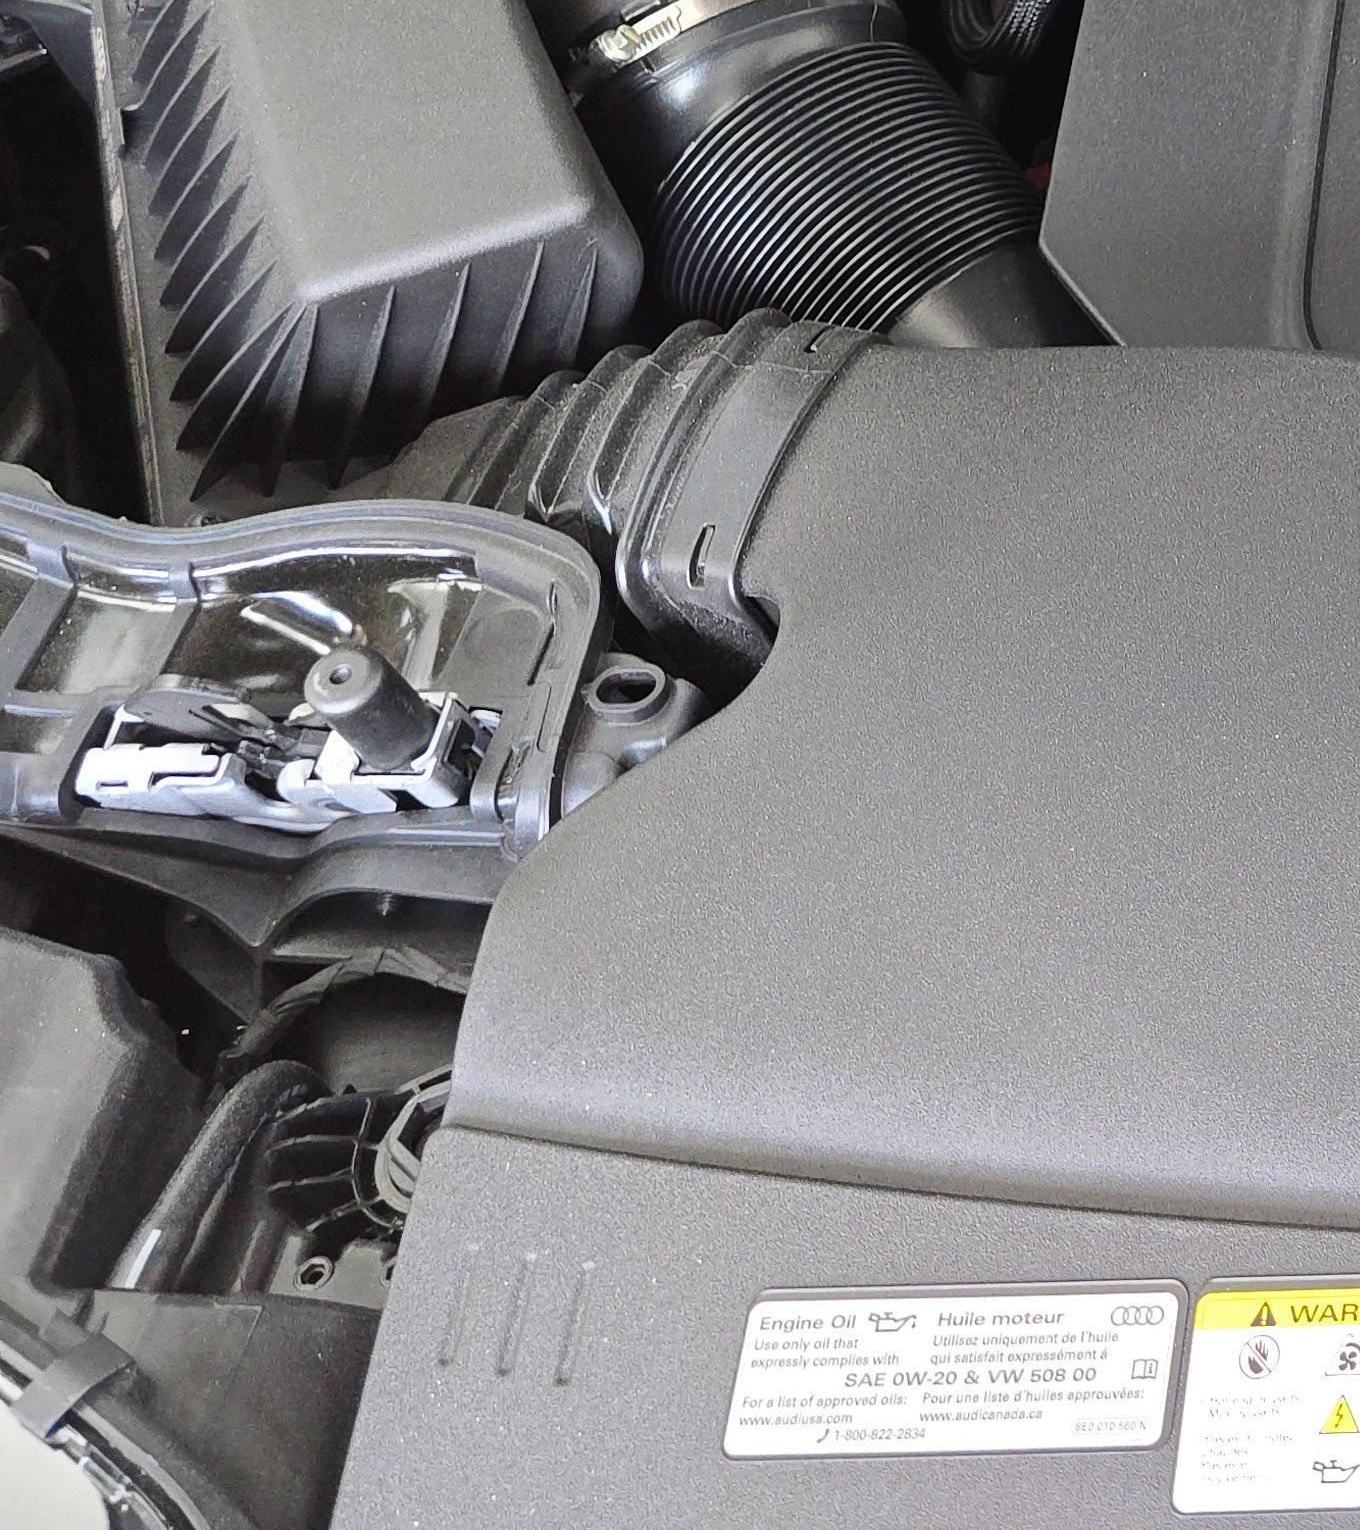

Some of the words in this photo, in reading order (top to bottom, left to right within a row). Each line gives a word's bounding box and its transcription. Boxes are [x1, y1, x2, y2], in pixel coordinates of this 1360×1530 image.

[759, 1316, 824, 1333] Engine
[831, 1314, 857, 1330] Oil
[938, 1311, 986, 1327] Huile
[991, 1311, 1065, 1326] moteur
[754, 1339, 779, 1351] Use
[782, 1338, 809, 1352] only
[814, 1337, 830, 1350] oil
[833, 1337, 858, 1350] that
[932, 1334, 979, 1347] Utilisez
[982, 1332, 1058, 1348] uniquement
[1061, 1331, 1077, 1344] de
[751, 1356, 809, 1369] expressly
[813, 1354, 869, 1368] complies
[873, 1352, 899, 1365] with
[930, 1352, 951, 1366] qui
[954, 1350, 1003, 1364] satisfait
[844, 1372, 886, 1387] SAE
[892, 1371, 957, 1386] 0W-20
[964, 1370, 980, 1385] &
[988, 1369, 1025, 1384] VW
[1030, 1368, 1066, 1383] 508
[1073, 1367, 1097, 1382] 00
[742, 1396, 763, 1408] For
[766, 1398, 774, 1408] a
[778, 1395, 796, 1408] list
[800, 1395, 814, 1407] of
[816, 1393, 877, 1409] approved
[880, 1393, 908, 1406] oils:
[922, 1392, 953, 1405] Pour
[956, 1392, 980, 1404] une
[983, 1390, 1010, 1403] liste
[739, 1413, 853, 1426] www.audiusa.com
[919, 1408, 1043, 1422] www.audicanada.ca
[834, 1427, 926, 1442] 1-800-822-2834
